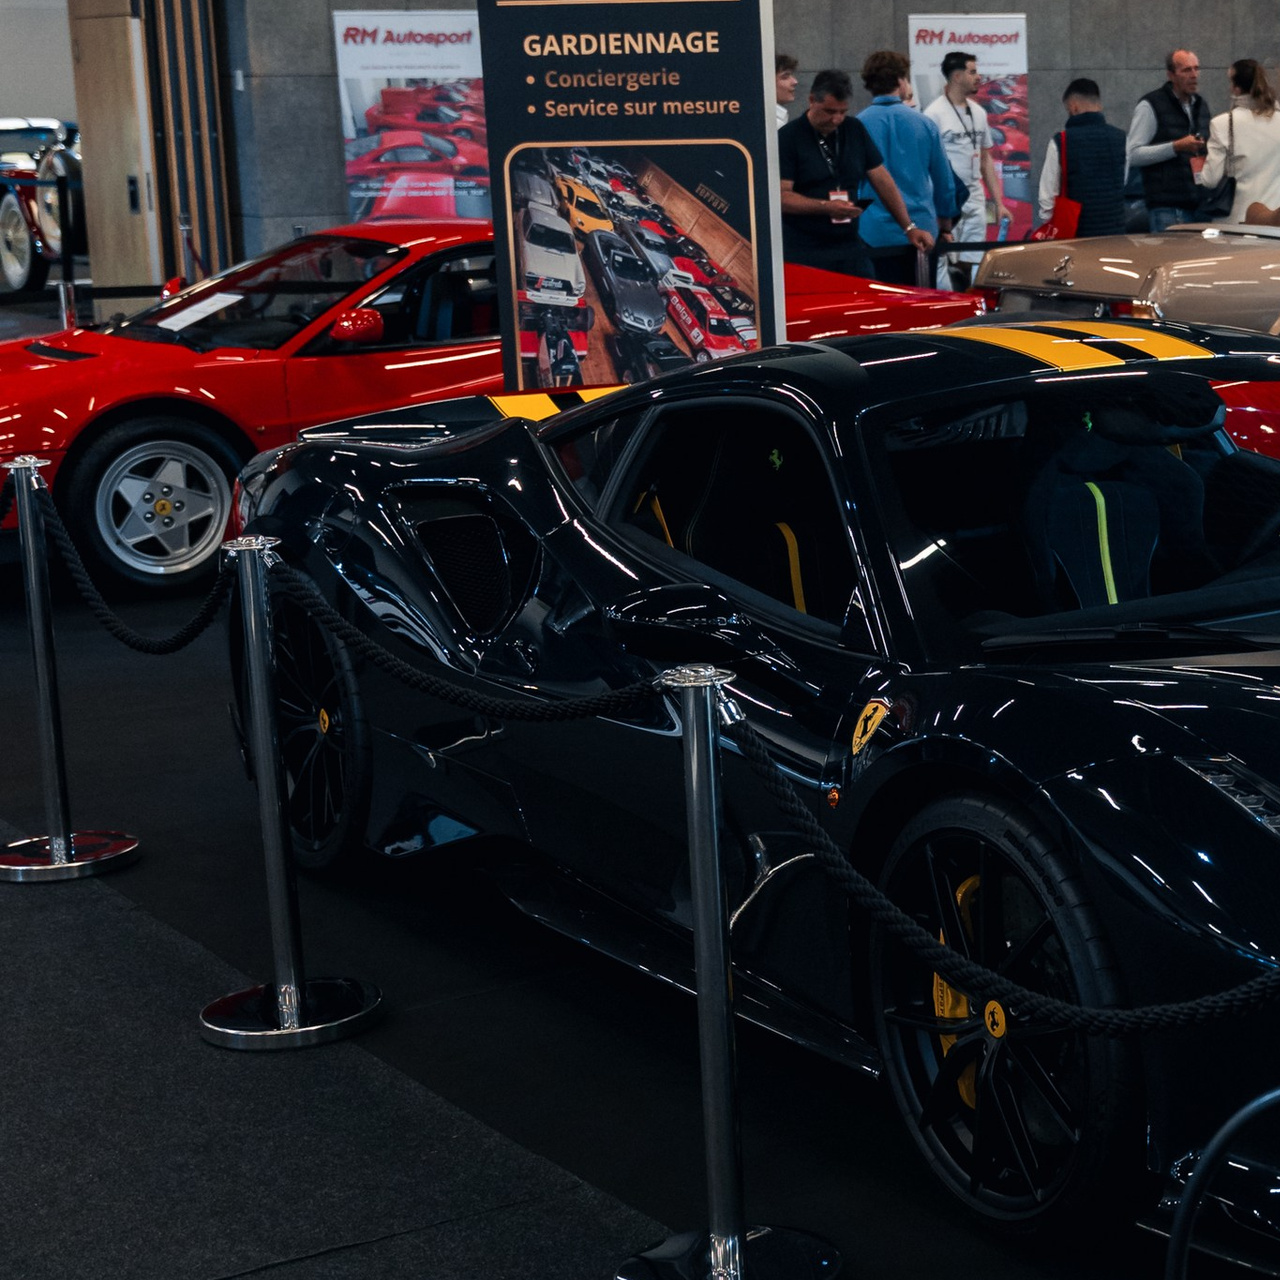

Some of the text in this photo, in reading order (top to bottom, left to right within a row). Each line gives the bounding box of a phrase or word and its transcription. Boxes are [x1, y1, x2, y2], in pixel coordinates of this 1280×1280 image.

[343, 26, 473, 49] RM Autosport
[523, 31, 720, 57] GARDIENNAGE
[915, 28, 1020, 48] RM Autosport
[544, 67, 680, 92] Conciergerie
[544, 99, 741, 118] Service sur mesure
